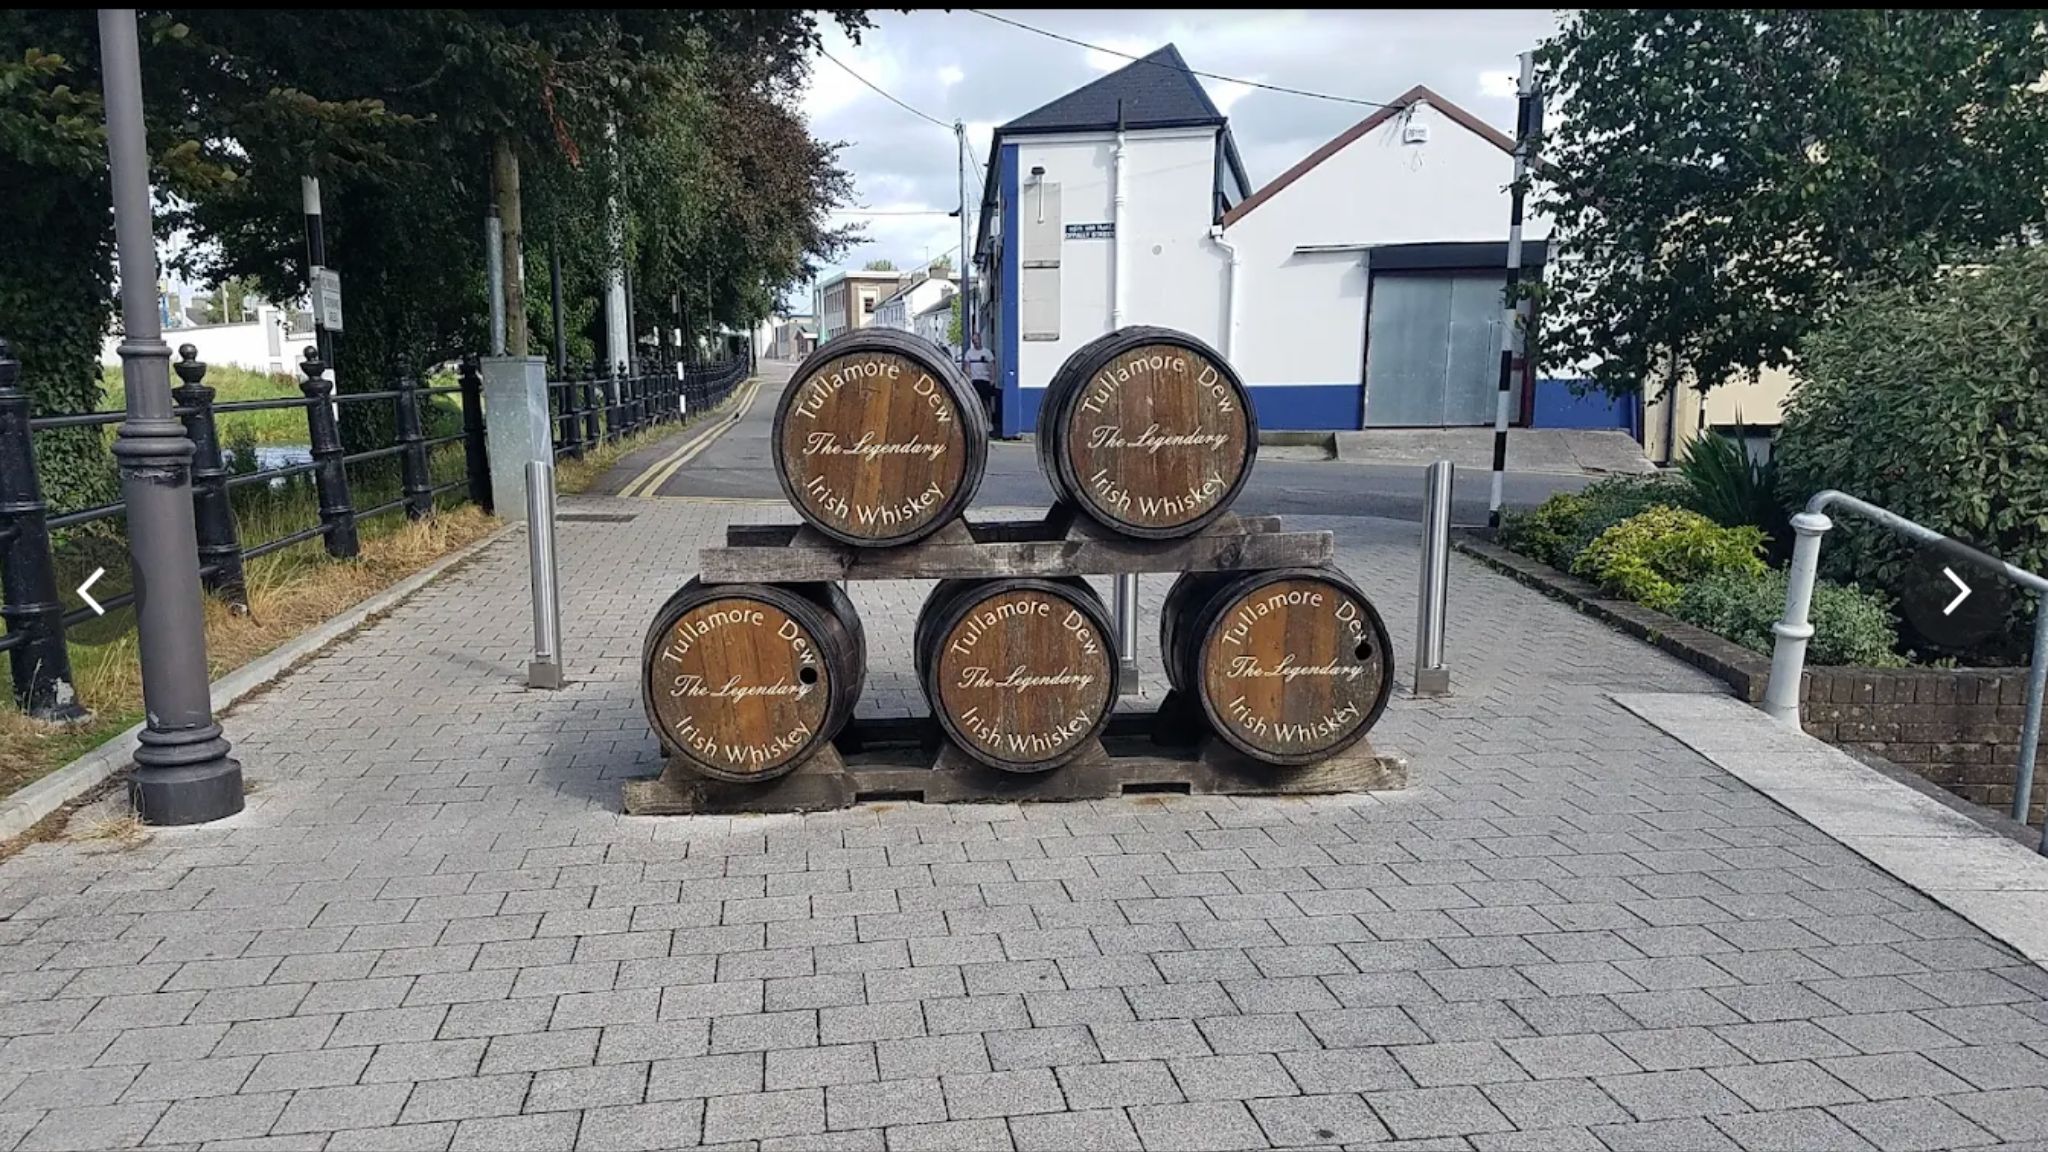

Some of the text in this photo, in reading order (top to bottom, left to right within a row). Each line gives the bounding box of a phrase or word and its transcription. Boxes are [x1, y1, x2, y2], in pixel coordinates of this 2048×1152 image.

[795, 361, 951, 423] Tullamore Dew
[1082, 356, 1234, 414] Tullamore Dew
[803, 431, 947, 462] The Legendary
[1088, 423, 1228, 453] The Legendary
[807, 475, 945, 525] Irish Whiskey
[1091, 469, 1227, 516] Irish Whiskey
[662, 609, 816, 665] Tullamore Dew
[951, 601, 1098, 655] Tullamore Dew
[1222, 591, 1323, 645] Tullamore
[670, 675, 812, 703] The Legendary
[958, 665, 1094, 694] The Legendary
[1227, 654, 1364, 683] The Legendary
[676, 716, 812, 764] Irish Whiskey
[961, 706, 1092, 753] Irish Whiskey
[1229, 696, 1359, 743] Irish Whiskey
